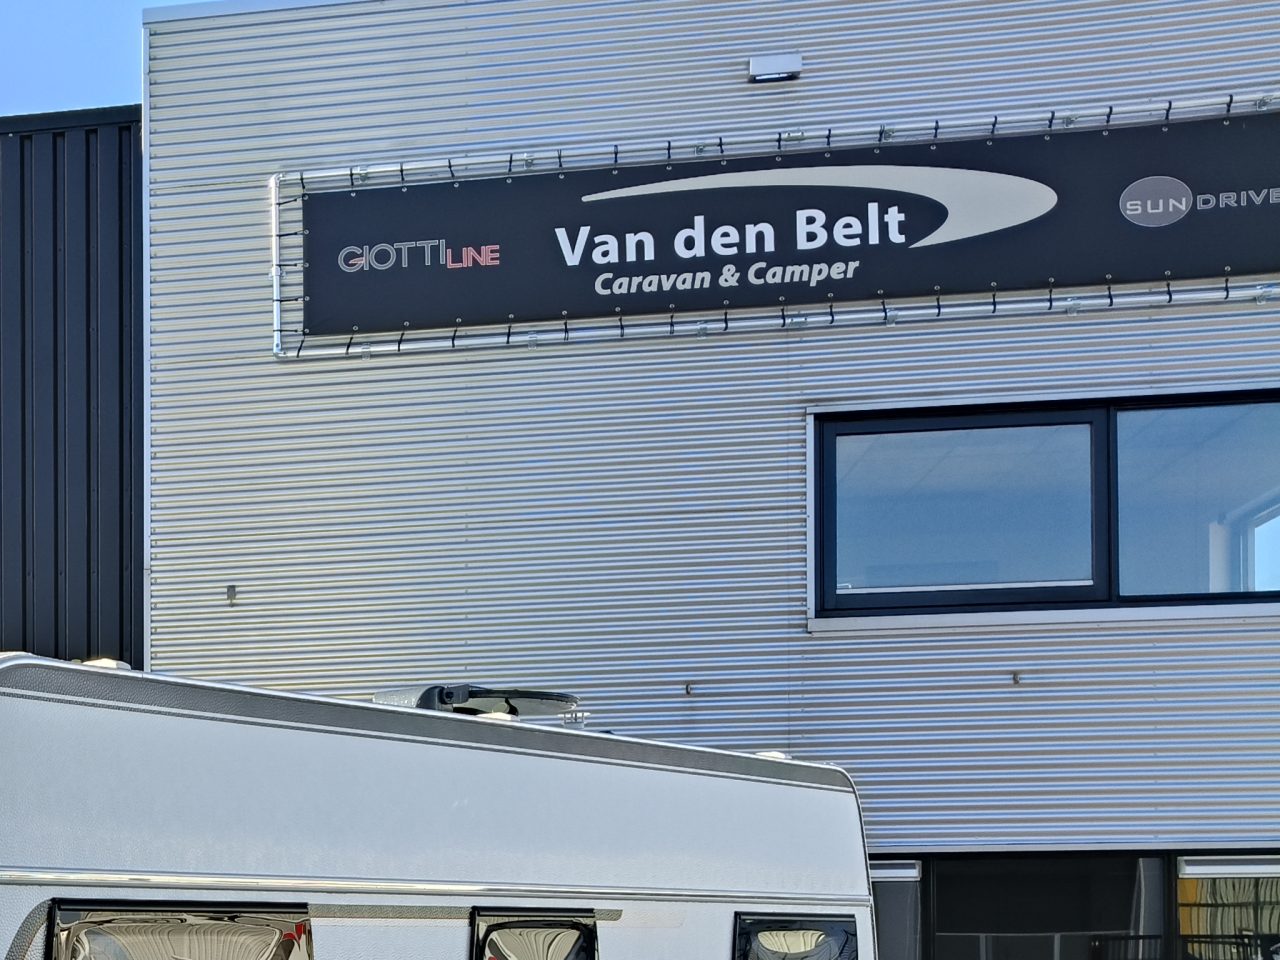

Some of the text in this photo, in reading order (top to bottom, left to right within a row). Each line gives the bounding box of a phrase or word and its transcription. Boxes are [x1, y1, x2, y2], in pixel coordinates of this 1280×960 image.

[1126, 197, 1187, 215] SUN
[554, 201, 906, 266] Van den Belt
[594, 260, 860, 296] Caravan & Camper
